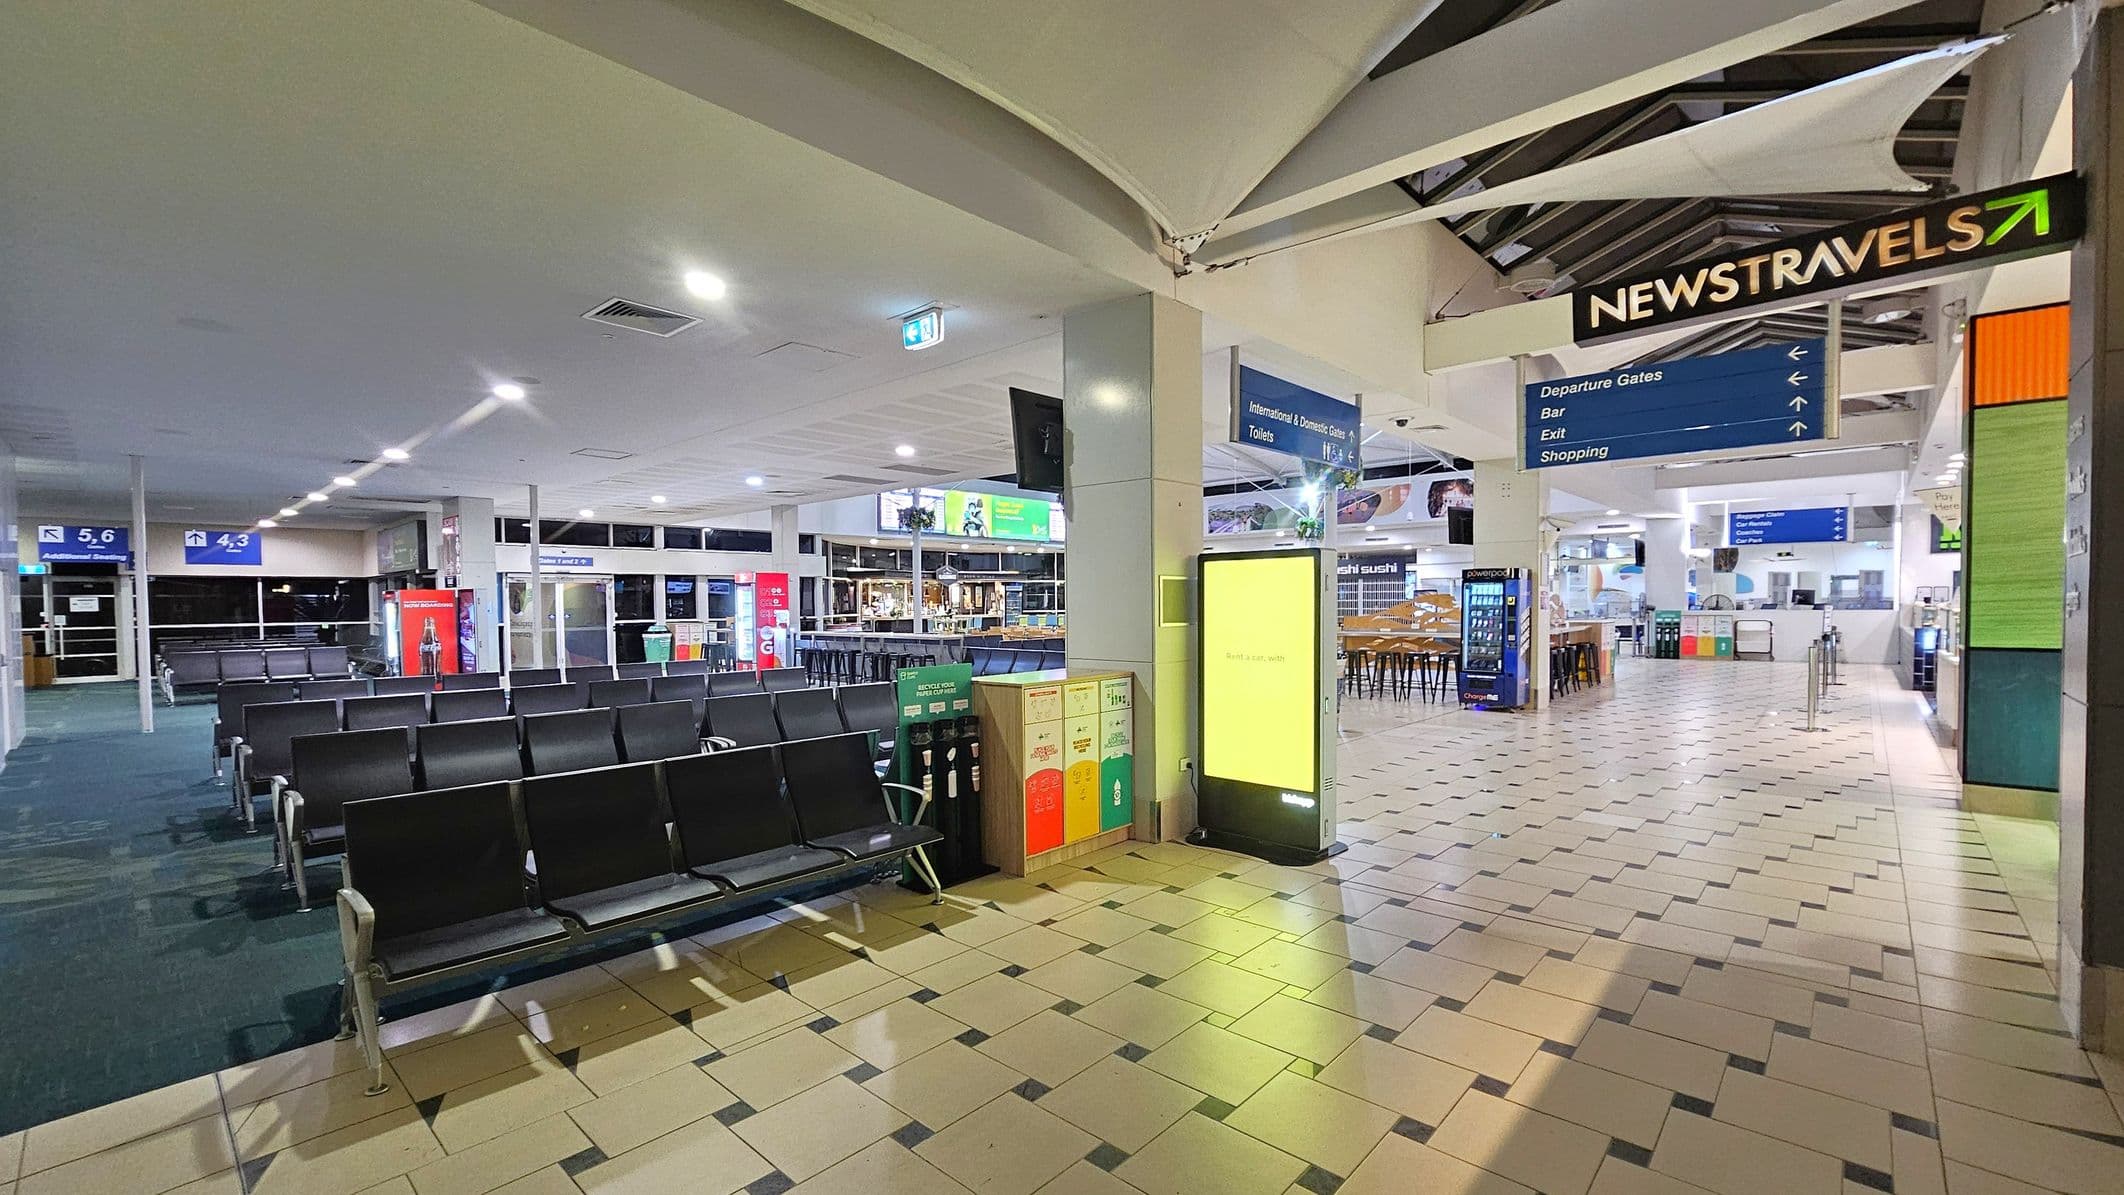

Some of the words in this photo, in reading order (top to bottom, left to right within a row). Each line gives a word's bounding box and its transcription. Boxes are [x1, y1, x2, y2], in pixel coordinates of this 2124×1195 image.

[1591, 206, 1984, 328] NEWSTRAVELS
[1540, 378, 1613, 398] Departure
[1617, 371, 1663, 386] Gates
[1248, 400, 1293, 424] International
[1293, 414, 1299, 426] &
[1299, 416, 1328, 434] Domestic
[1329, 425, 1346, 440] Gates
[1540, 407, 1566, 420] Bar
[1248, 425, 1274, 443] Toilets
[1540, 427, 1567, 441] Exit
[1540, 446, 1609, 462] Shopping
[1935, 503, 1960, 511] Here
[77, 528, 116, 545] 5,6
[216, 533, 249, 549] 4,3
[42, 552, 92, 560] Additional
[92, 553, 127, 562] Seating
[1361, 562, 1398, 574] sushi
[1226, 651, 1244, 661] Rent
